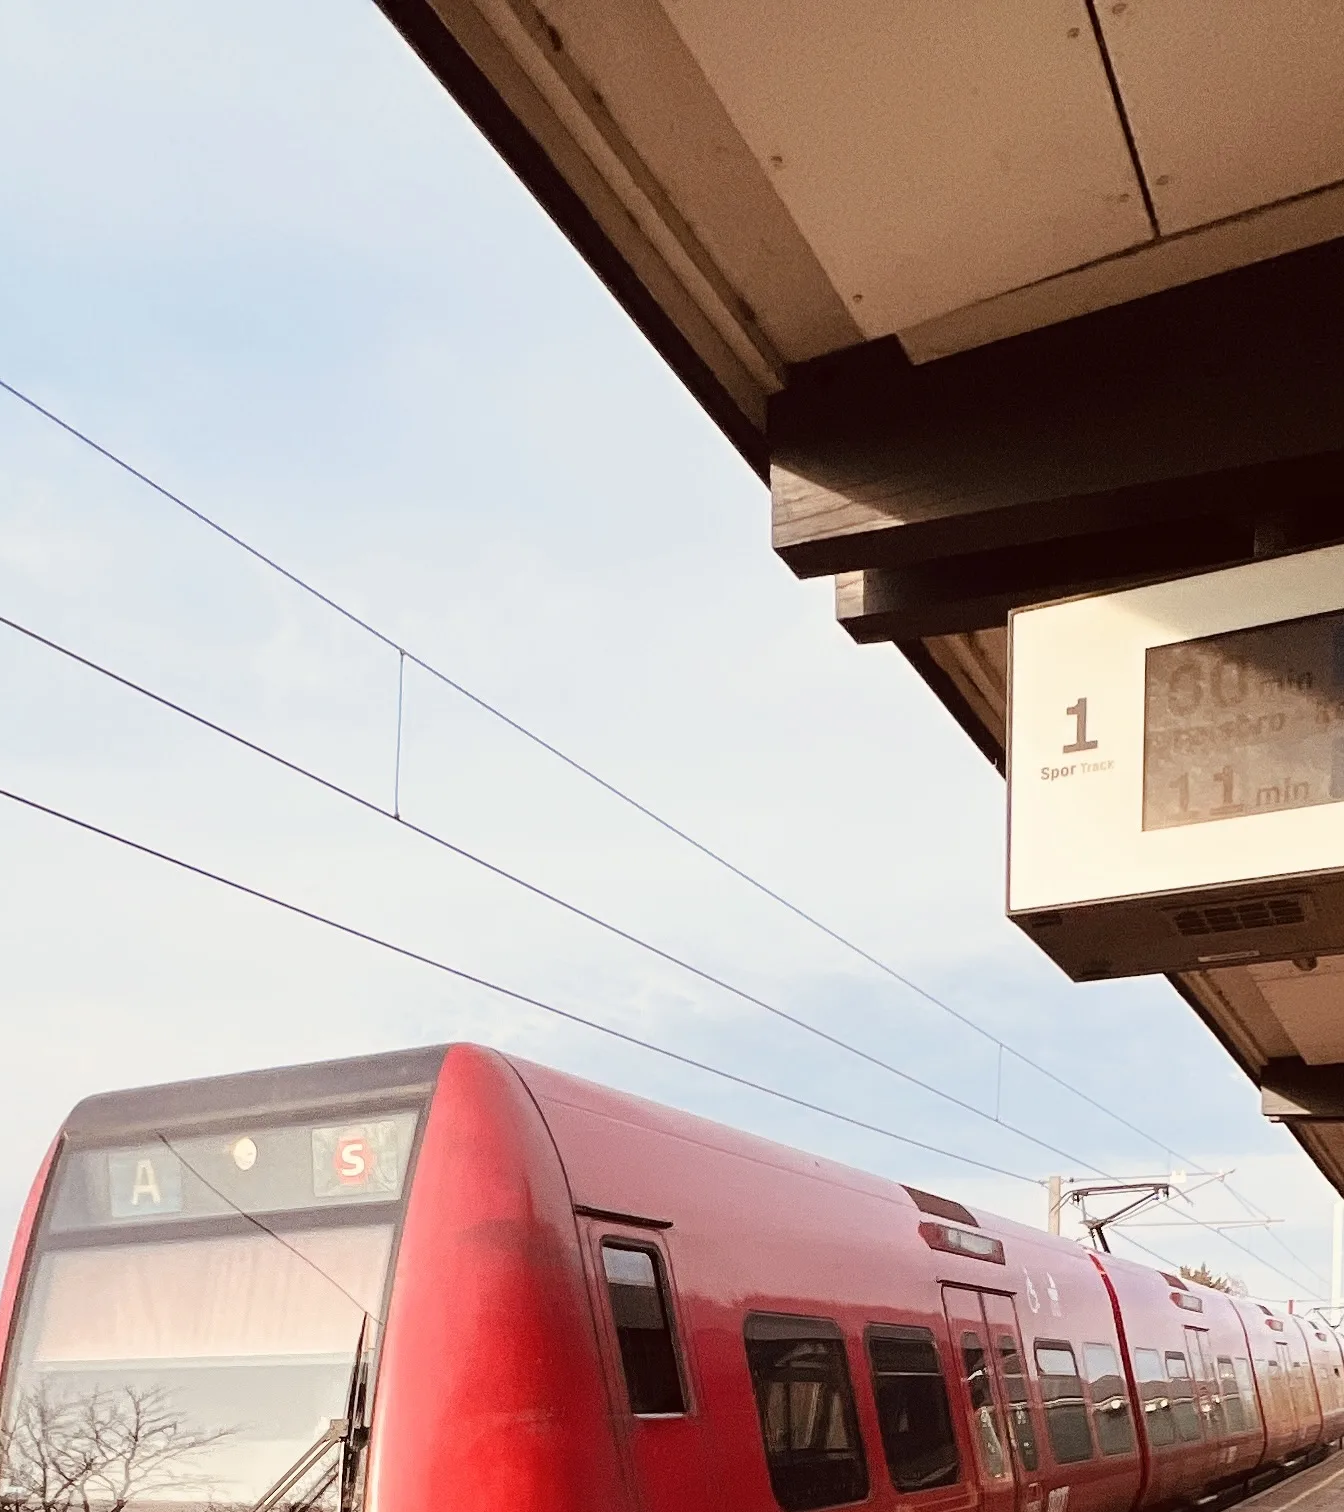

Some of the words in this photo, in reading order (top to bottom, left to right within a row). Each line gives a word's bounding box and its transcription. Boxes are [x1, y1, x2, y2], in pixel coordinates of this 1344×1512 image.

[1062, 697, 1098, 754] 1
[1040, 766, 1076, 781] Spor
[1080, 760, 1115, 774] Track
[1168, 765, 1244, 817] 11
[1257, 777, 1308, 807] min
[131, 1159, 161, 1206] A
[340, 1143, 366, 1177] S
